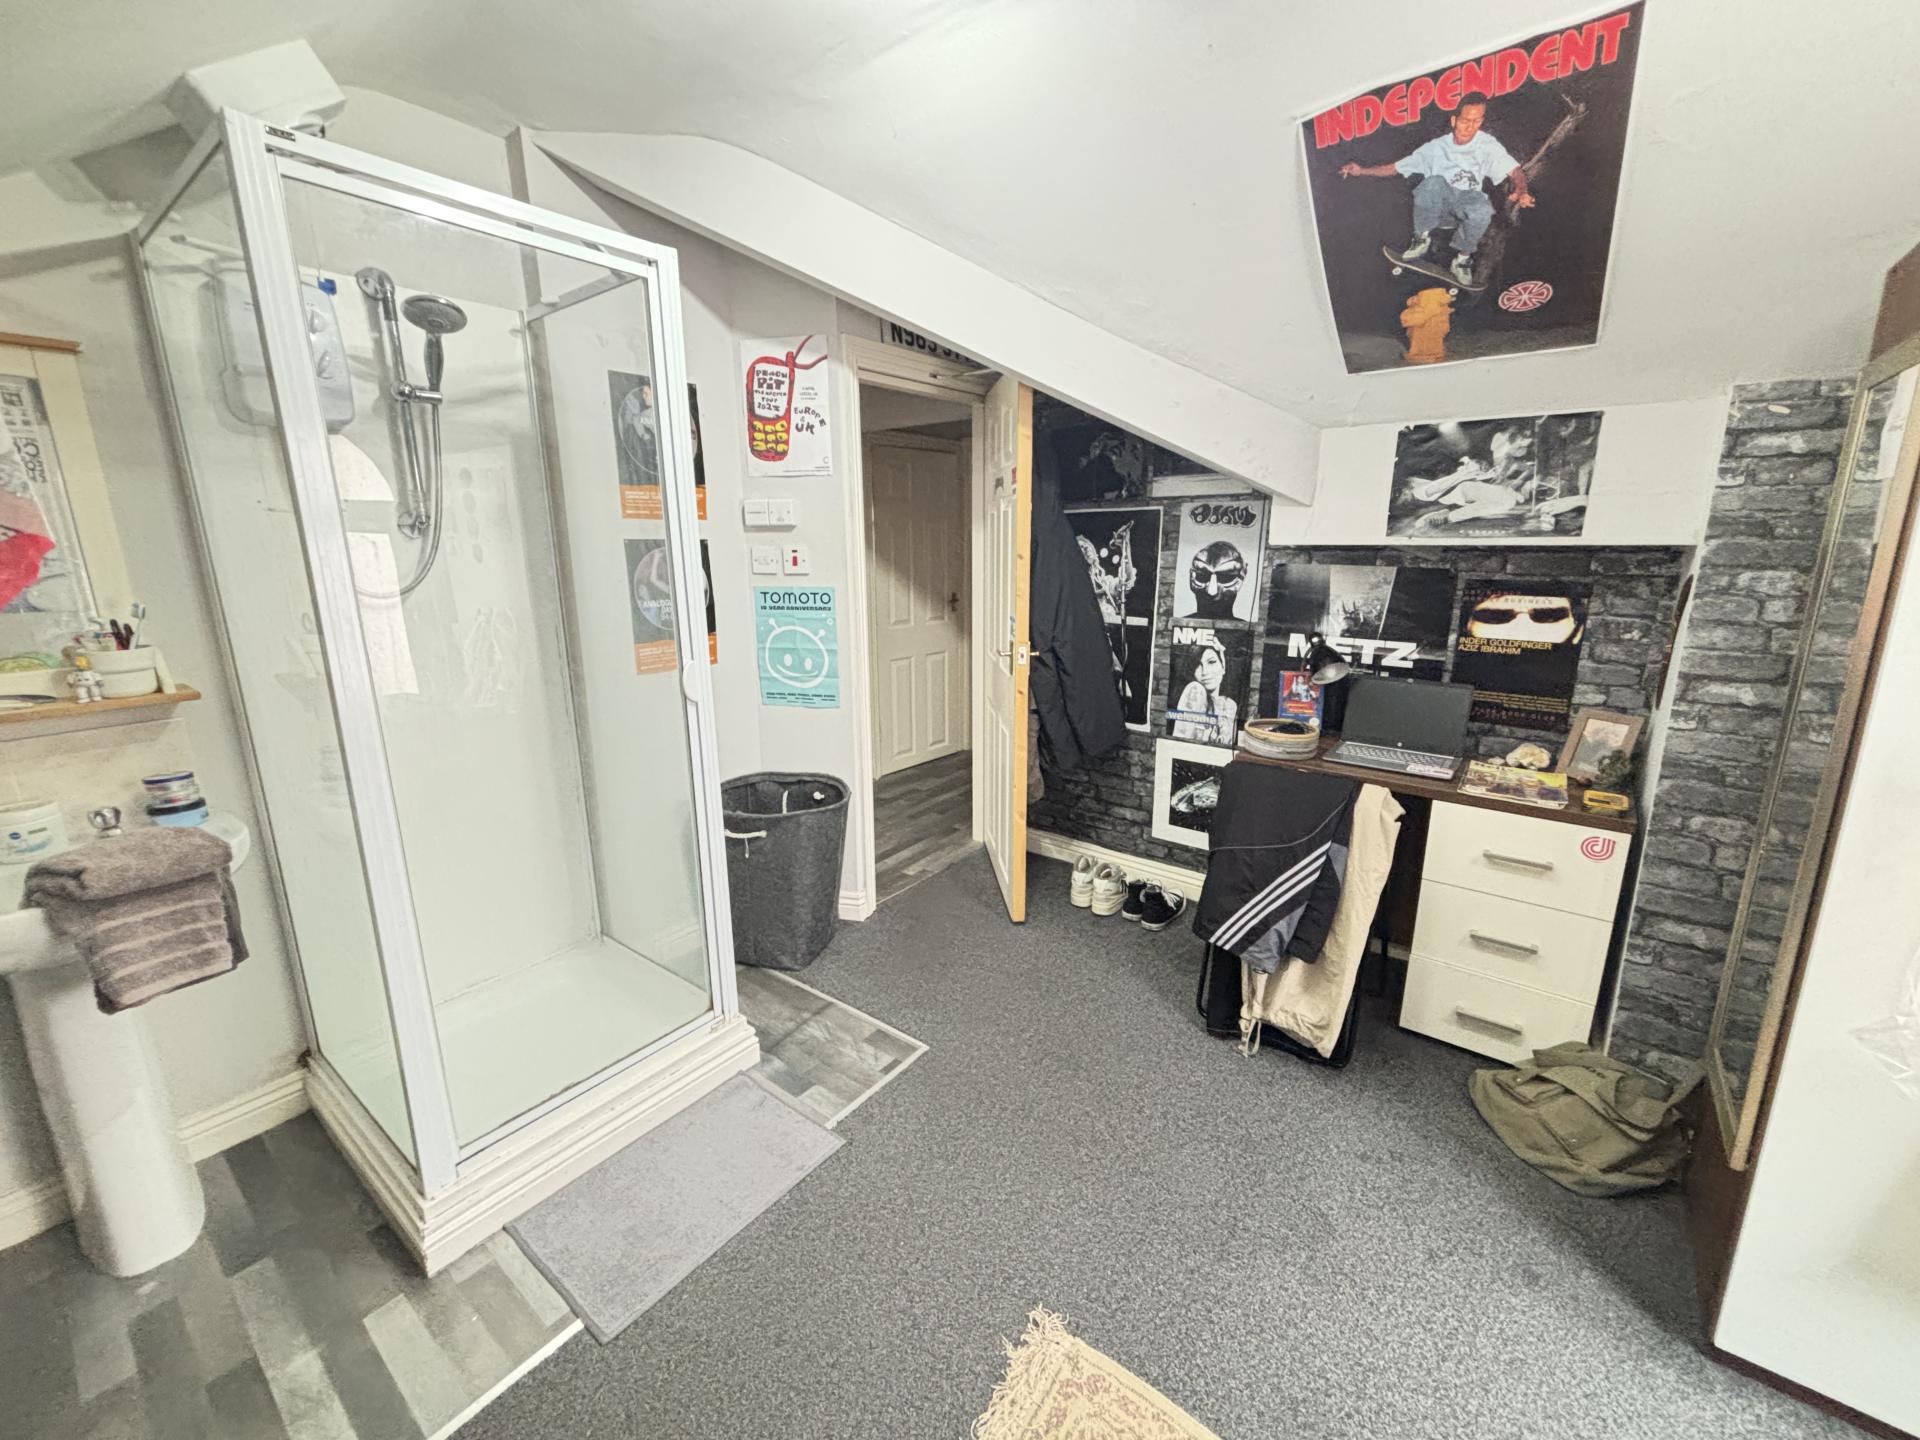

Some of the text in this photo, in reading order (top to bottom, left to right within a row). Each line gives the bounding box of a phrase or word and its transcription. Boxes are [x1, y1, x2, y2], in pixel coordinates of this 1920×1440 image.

[1312, 12, 1631, 149] INDEPENDENT
[757, 377, 785, 390] PIT
[794, 406, 826, 427] EUROPE
[795, 422, 815, 435] UK
[760, 591, 831, 604] TOMOTO
[1173, 626, 1215, 646] NME
[1458, 644, 1521, 655] AZIZ IBRAHIM
[1460, 636, 1553, 650] INDER GOLDFINGER
